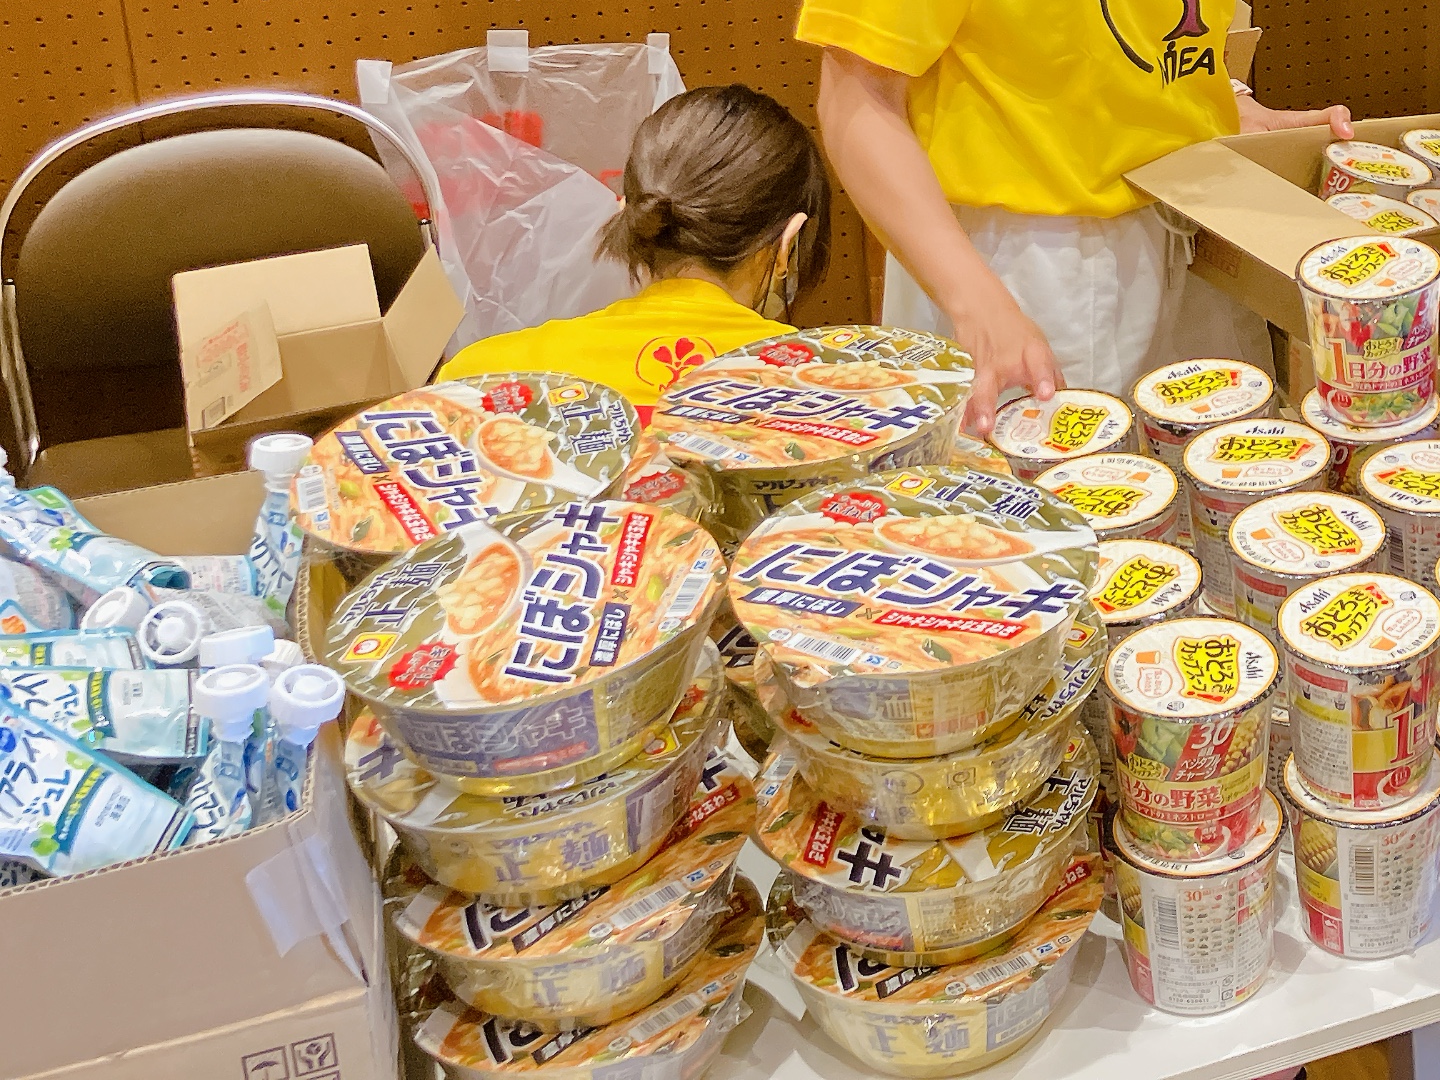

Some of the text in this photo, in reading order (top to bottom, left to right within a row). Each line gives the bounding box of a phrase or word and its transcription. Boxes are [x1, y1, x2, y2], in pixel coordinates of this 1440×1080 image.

[1328, 170, 1350, 192] 30
[667, 378, 935, 431] にぼシャキ
[612, 512, 650, 586] シャキシャキな玉ねぎ
[504, 502, 620, 684] にぼシャキ
[738, 544, 1080, 618] にぼシャキ
[753, 588, 847, 616] 濃厚にぼし
[592, 604, 629, 666] 濃厚にぼし
[880, 610, 1021, 639] シャキシャキな玉ねぎ
[1191, 719, 1235, 750] 30
